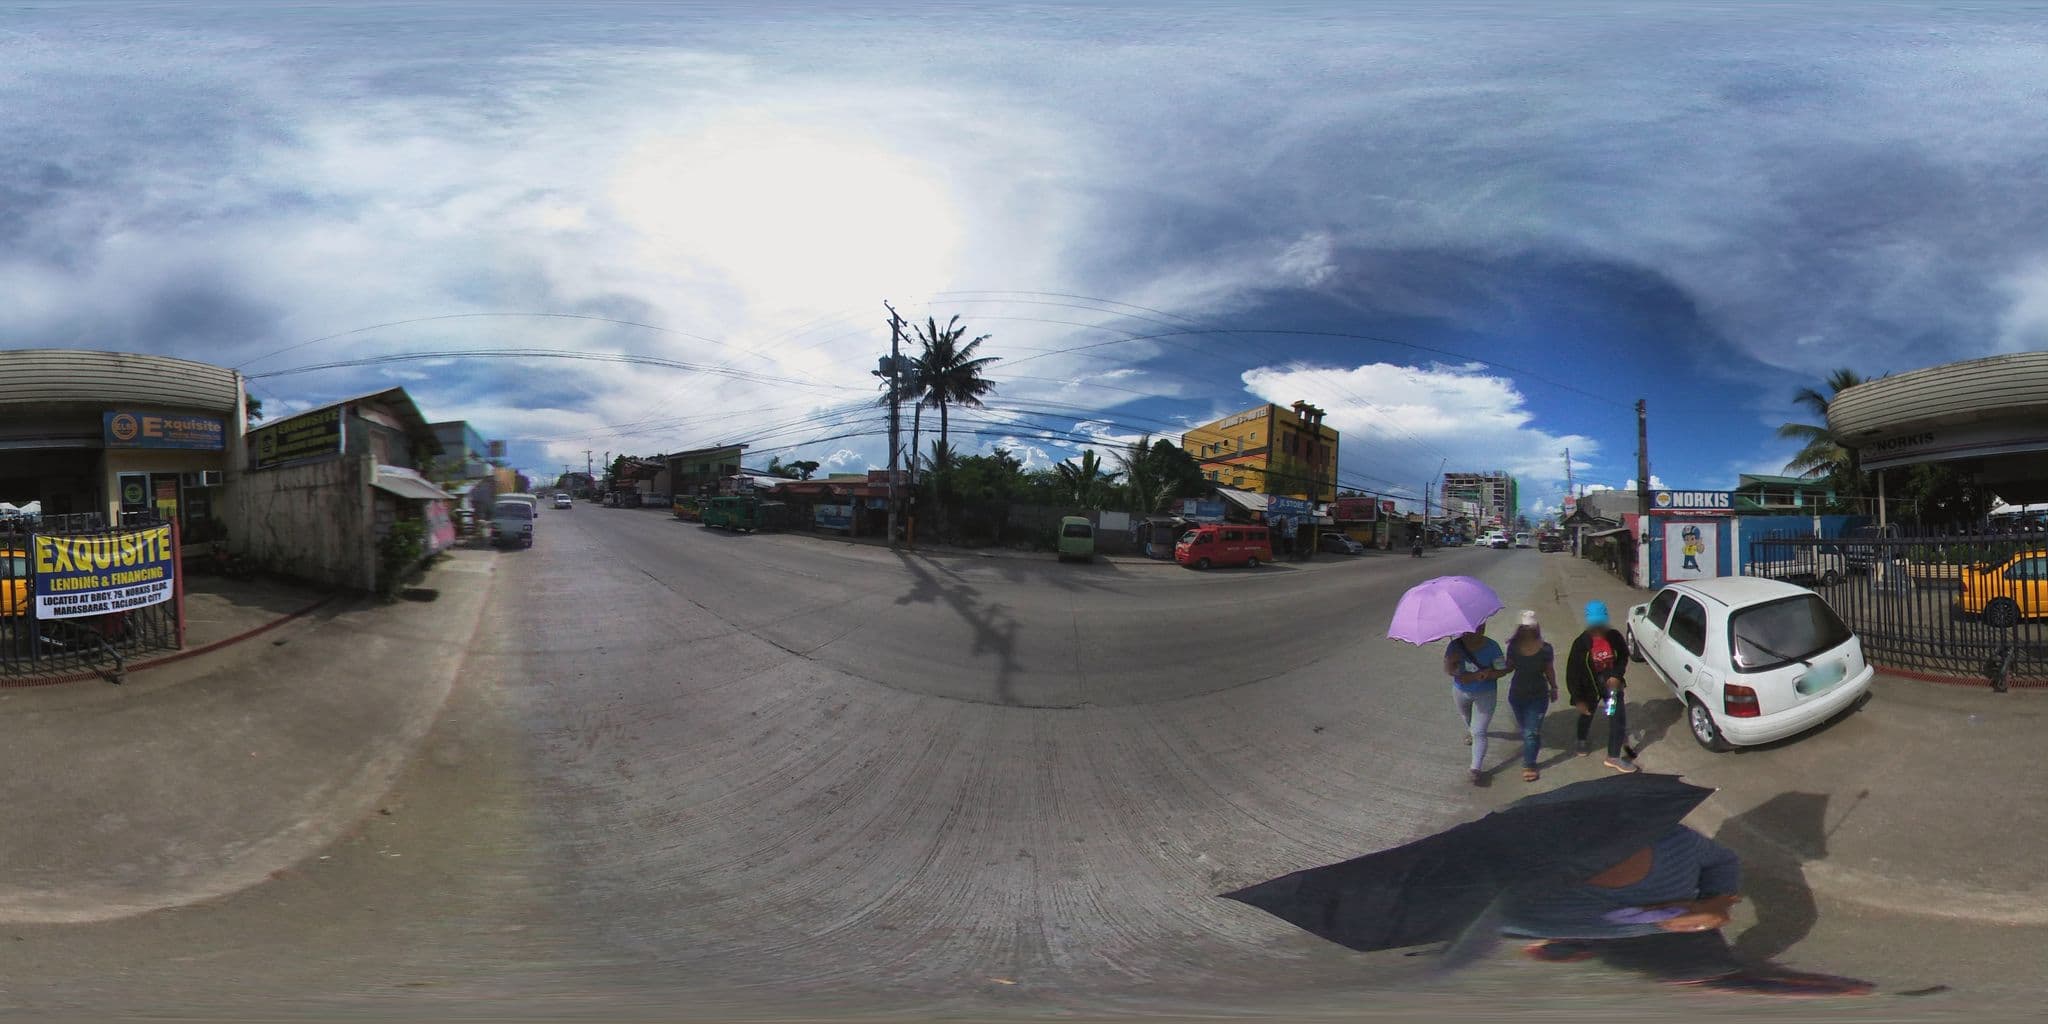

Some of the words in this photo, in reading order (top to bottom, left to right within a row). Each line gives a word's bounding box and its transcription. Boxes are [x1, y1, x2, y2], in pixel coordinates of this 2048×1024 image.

[142, 416, 222, 438] Exquisite
[1673, 492, 1729, 507] NORKIS
[36, 528, 171, 573] EXQUISITE
[50, 576, 99, 592] LENDING
[101, 574, 109, 586] &
[111, 566, 163, 585] FINANCING
[43, 595, 79, 606] LOCATED
[79, 594, 89, 604] AT
[125, 585, 151, 598] NORKIS
[111, 596, 147, 609] TACLOBAN
[148, 593, 162, 603] CITY
